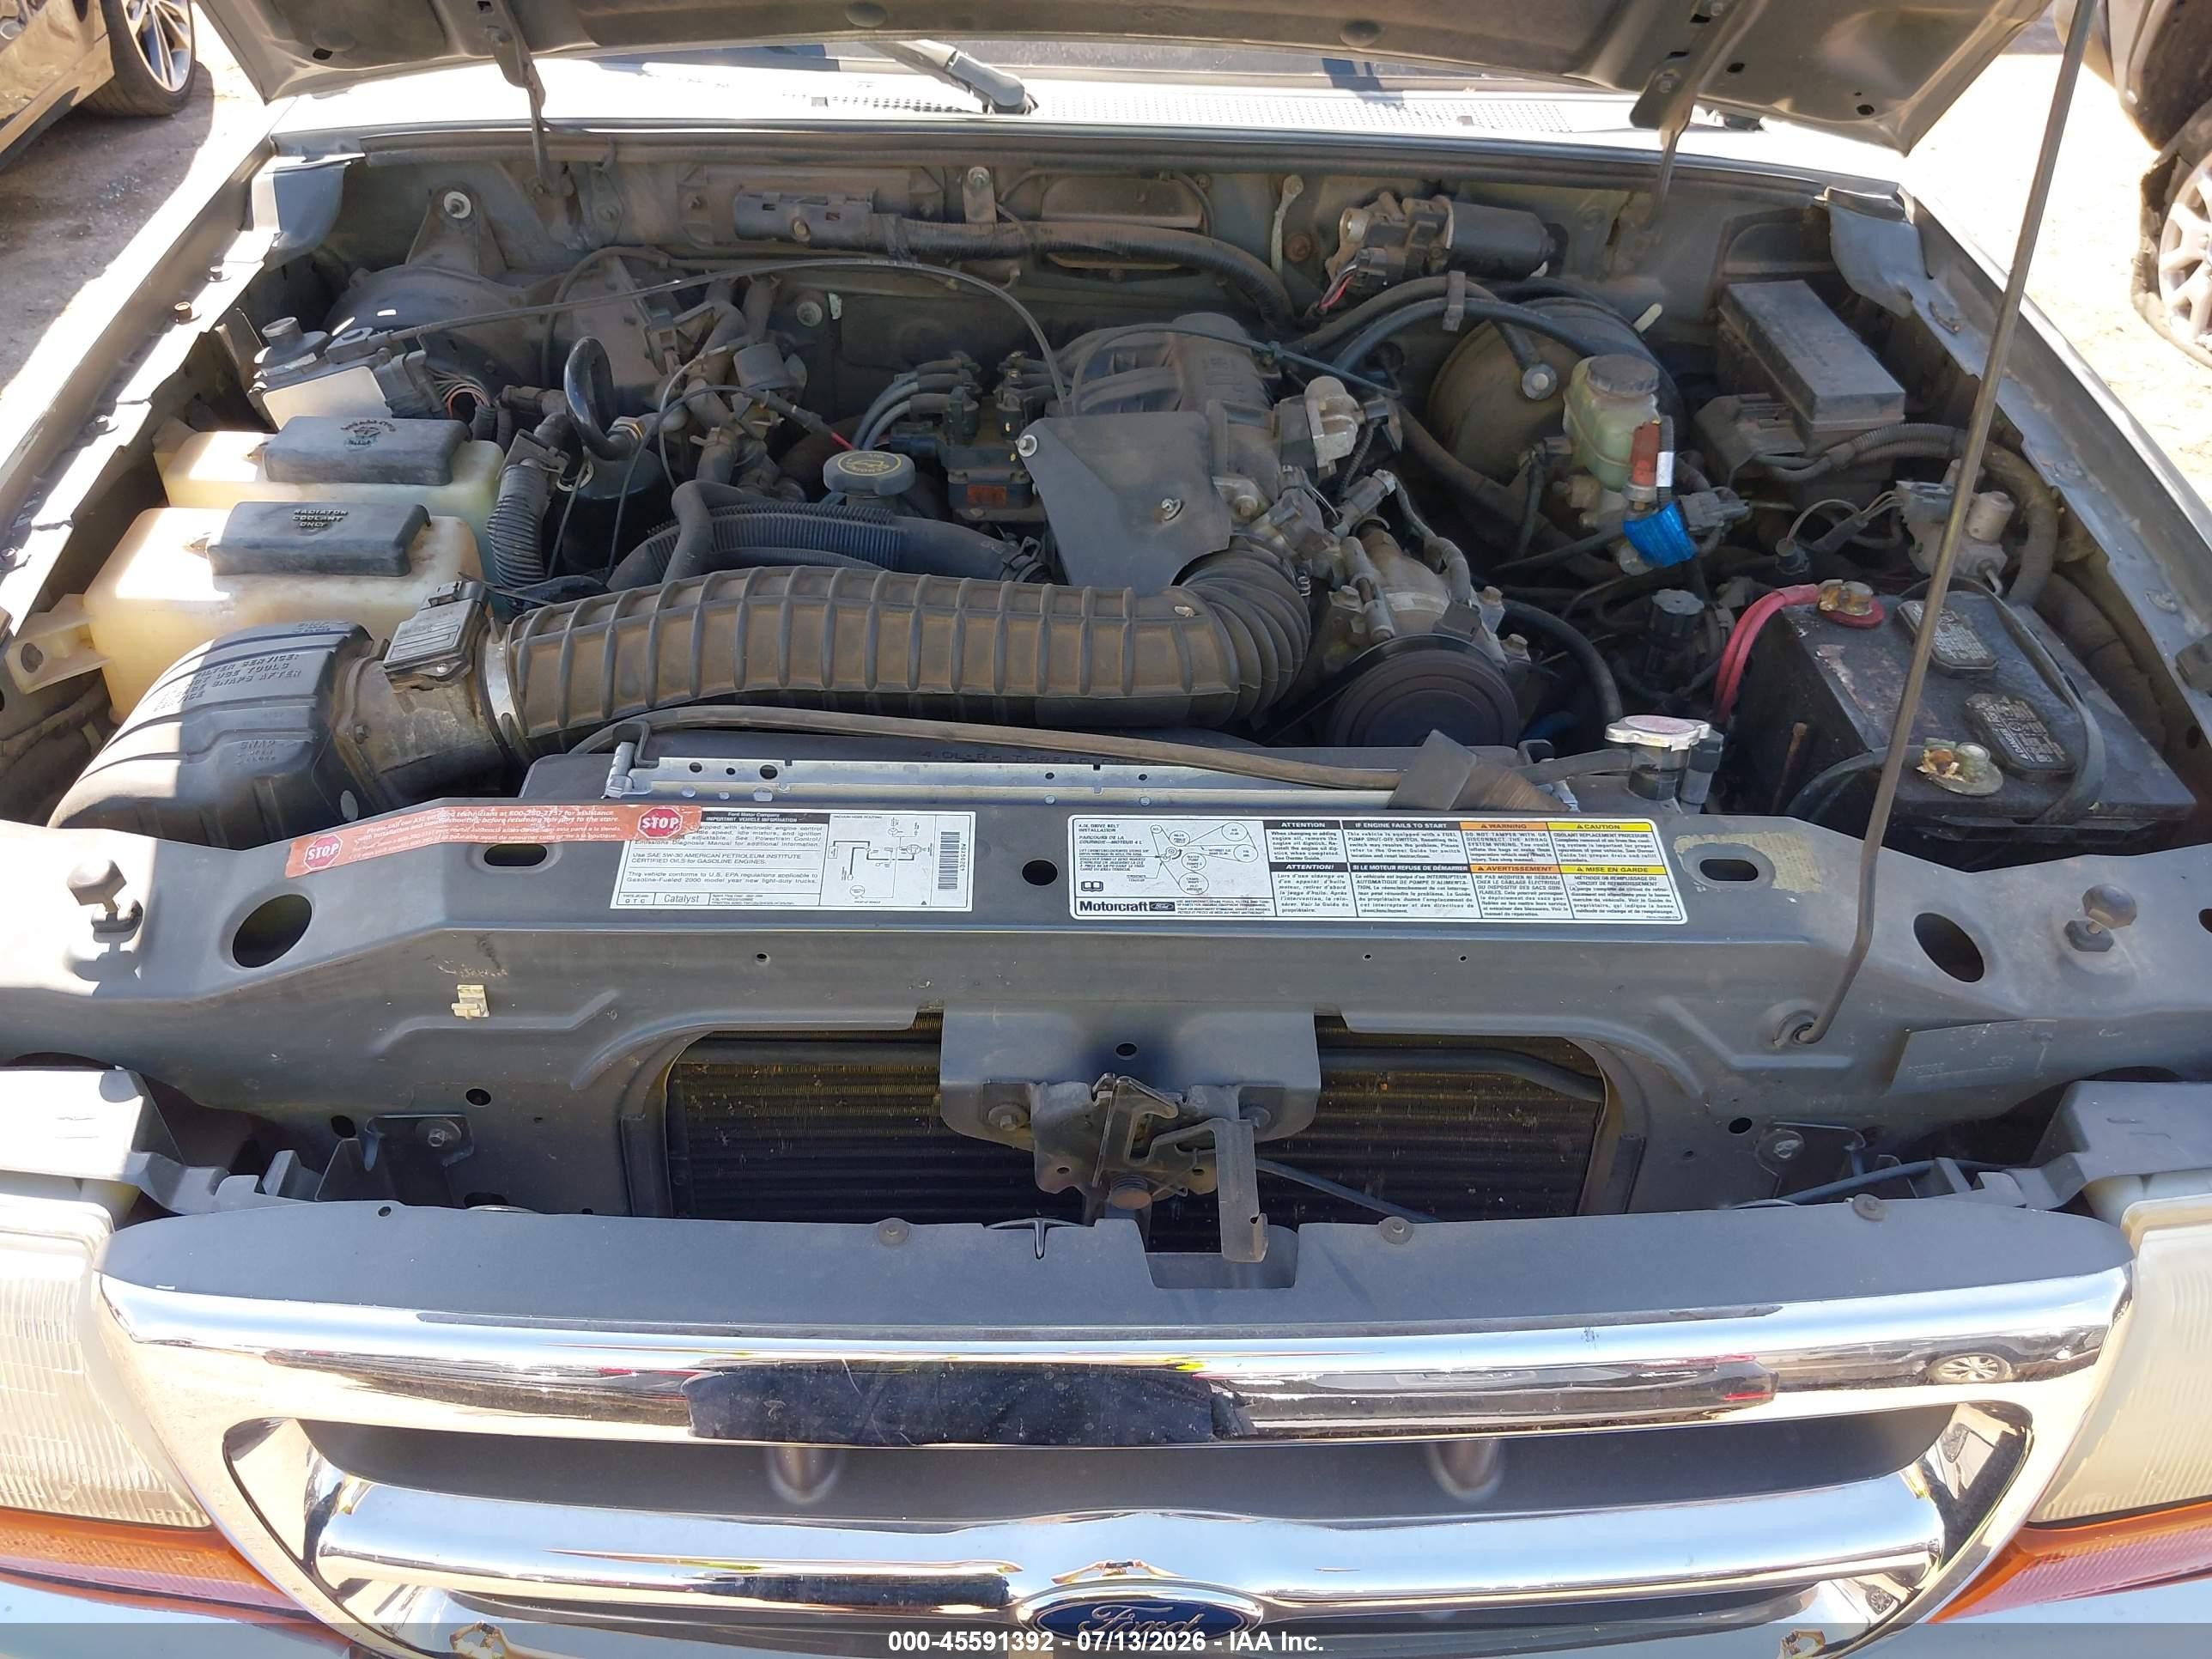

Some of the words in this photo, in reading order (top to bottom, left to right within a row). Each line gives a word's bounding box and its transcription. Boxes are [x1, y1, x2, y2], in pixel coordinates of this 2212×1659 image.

[642, 817, 678, 830] STOP
[307, 843, 339, 860] STOP
[664, 895, 699, 903] Catalyst
[1079, 902, 1148, 912] Motorcraft
[1078, 1604, 1205, 1634] Ford
